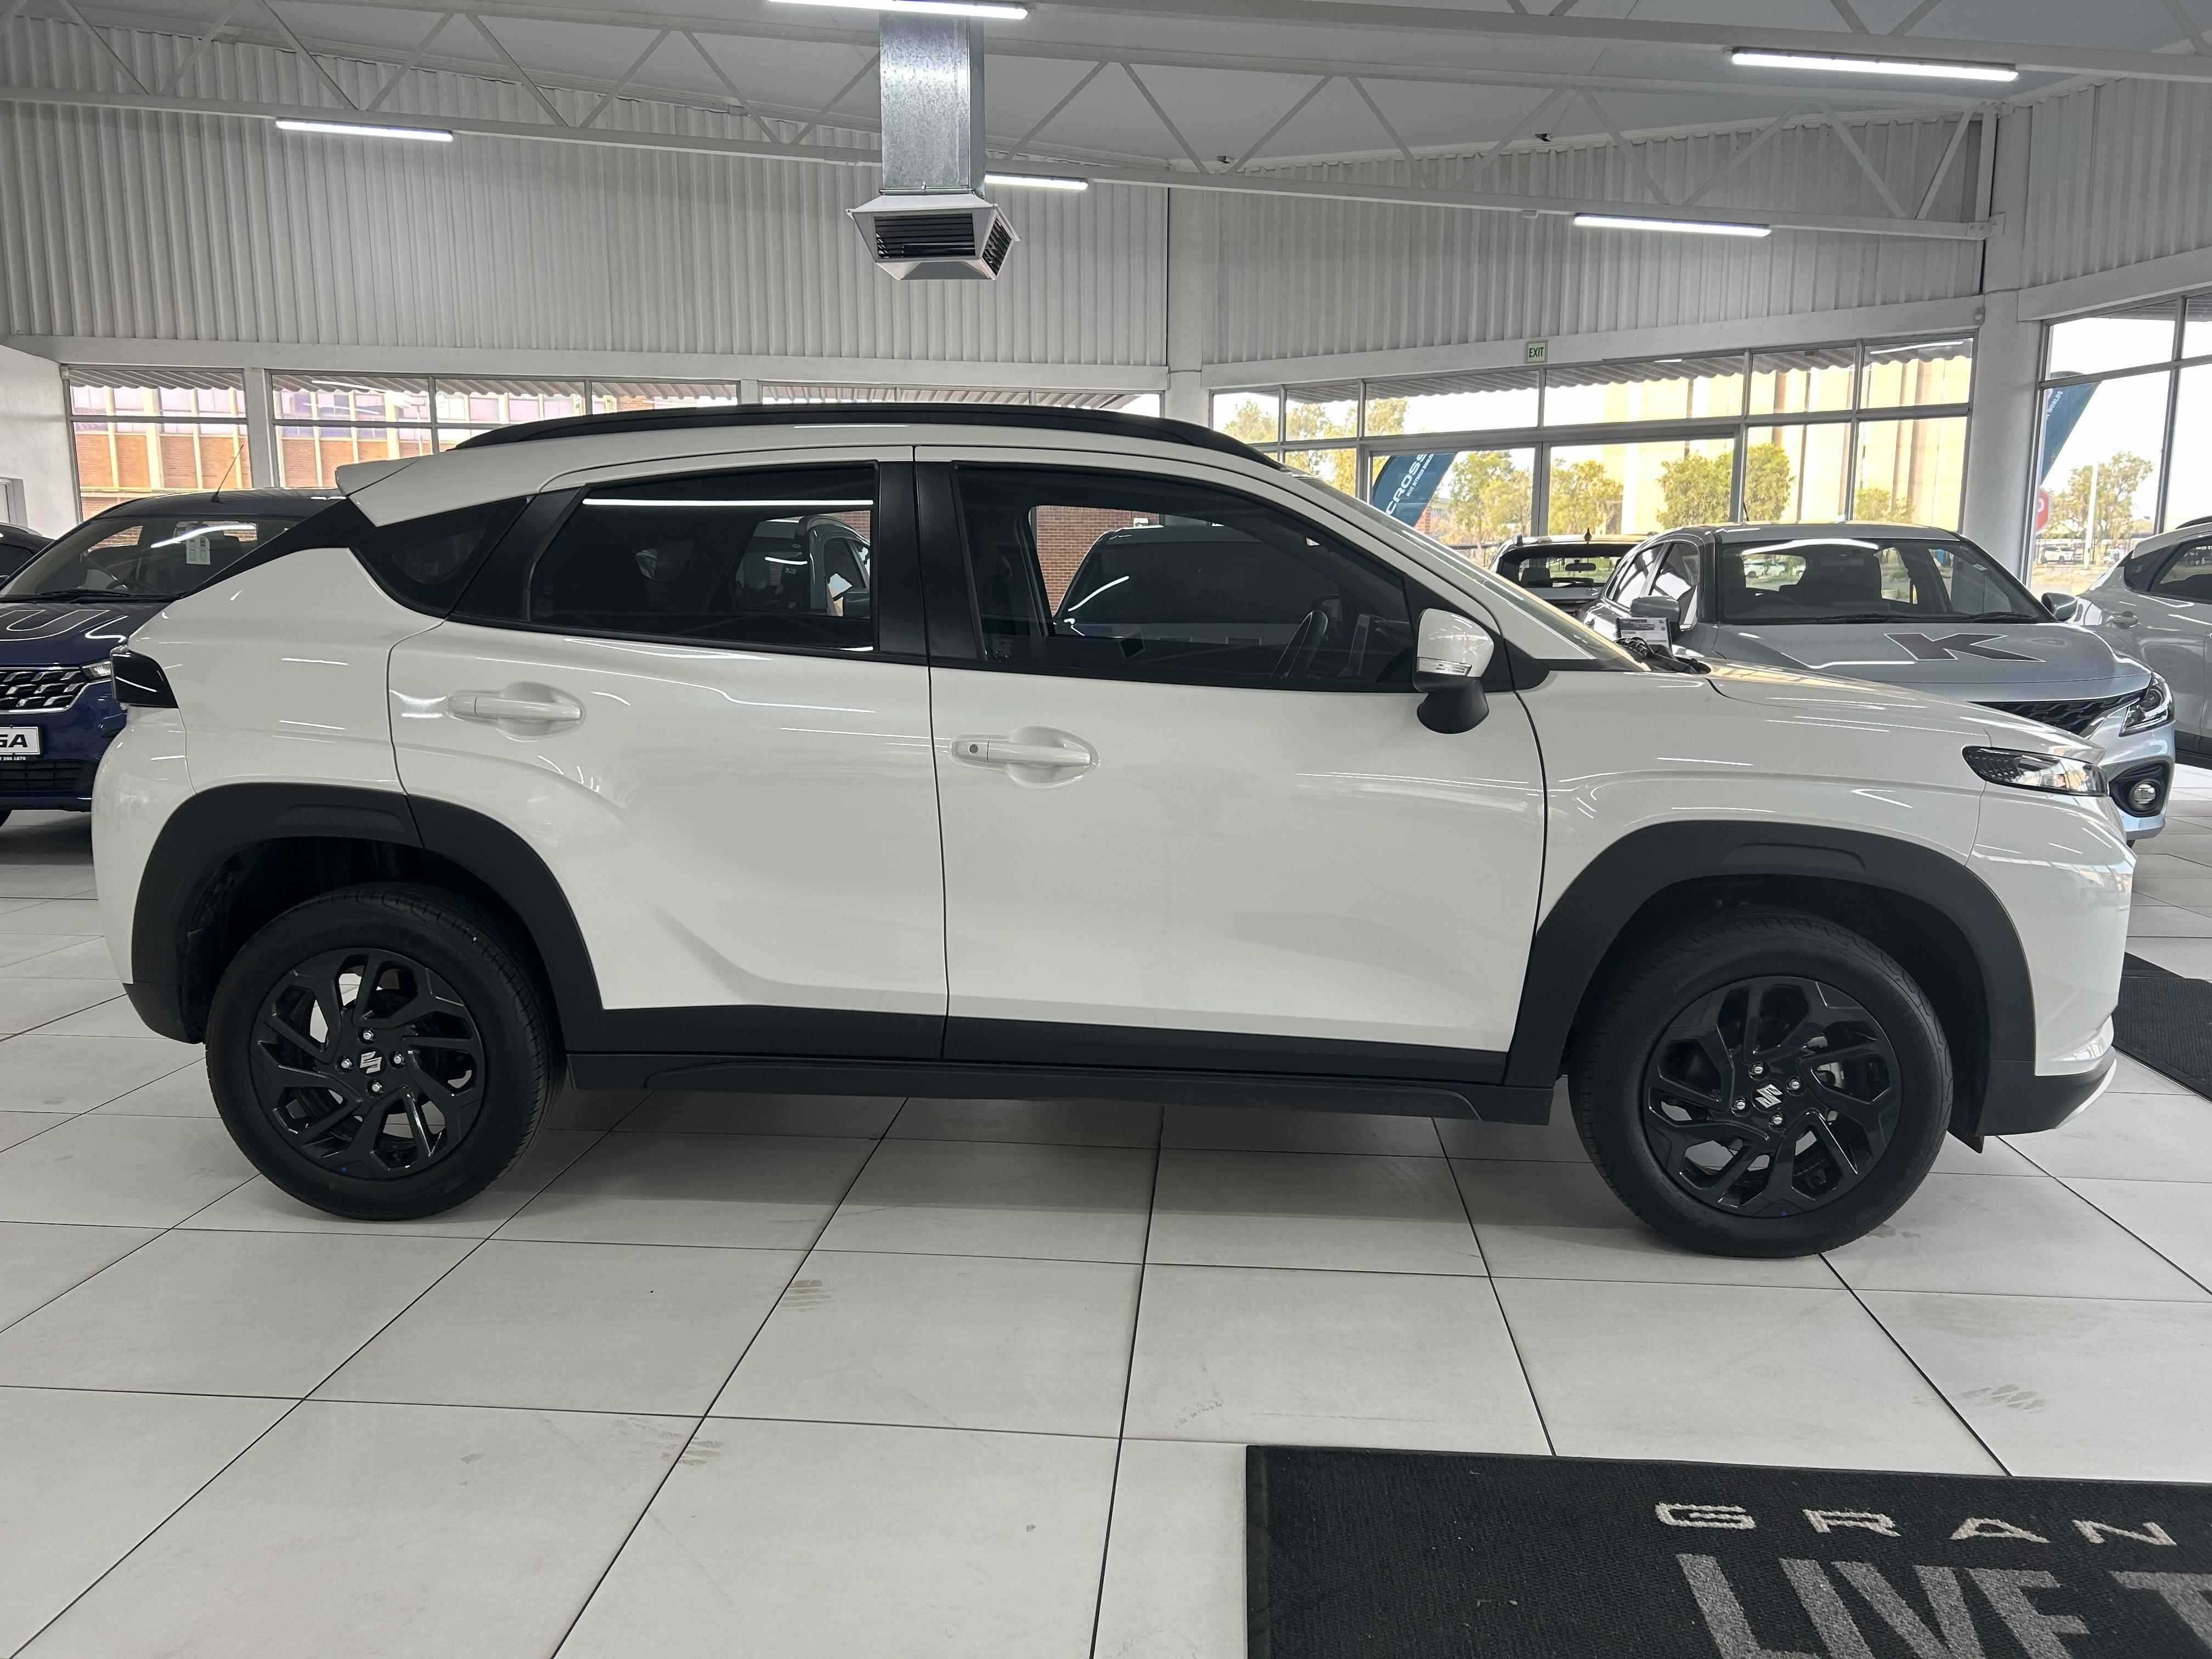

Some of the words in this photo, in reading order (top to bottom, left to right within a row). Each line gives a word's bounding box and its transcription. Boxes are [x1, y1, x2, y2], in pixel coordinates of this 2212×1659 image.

[1529, 347, 1544, 357] EXIT
[2049, 391, 2063, 413] WORLDS
[1385, 453, 1427, 515] CROSS
